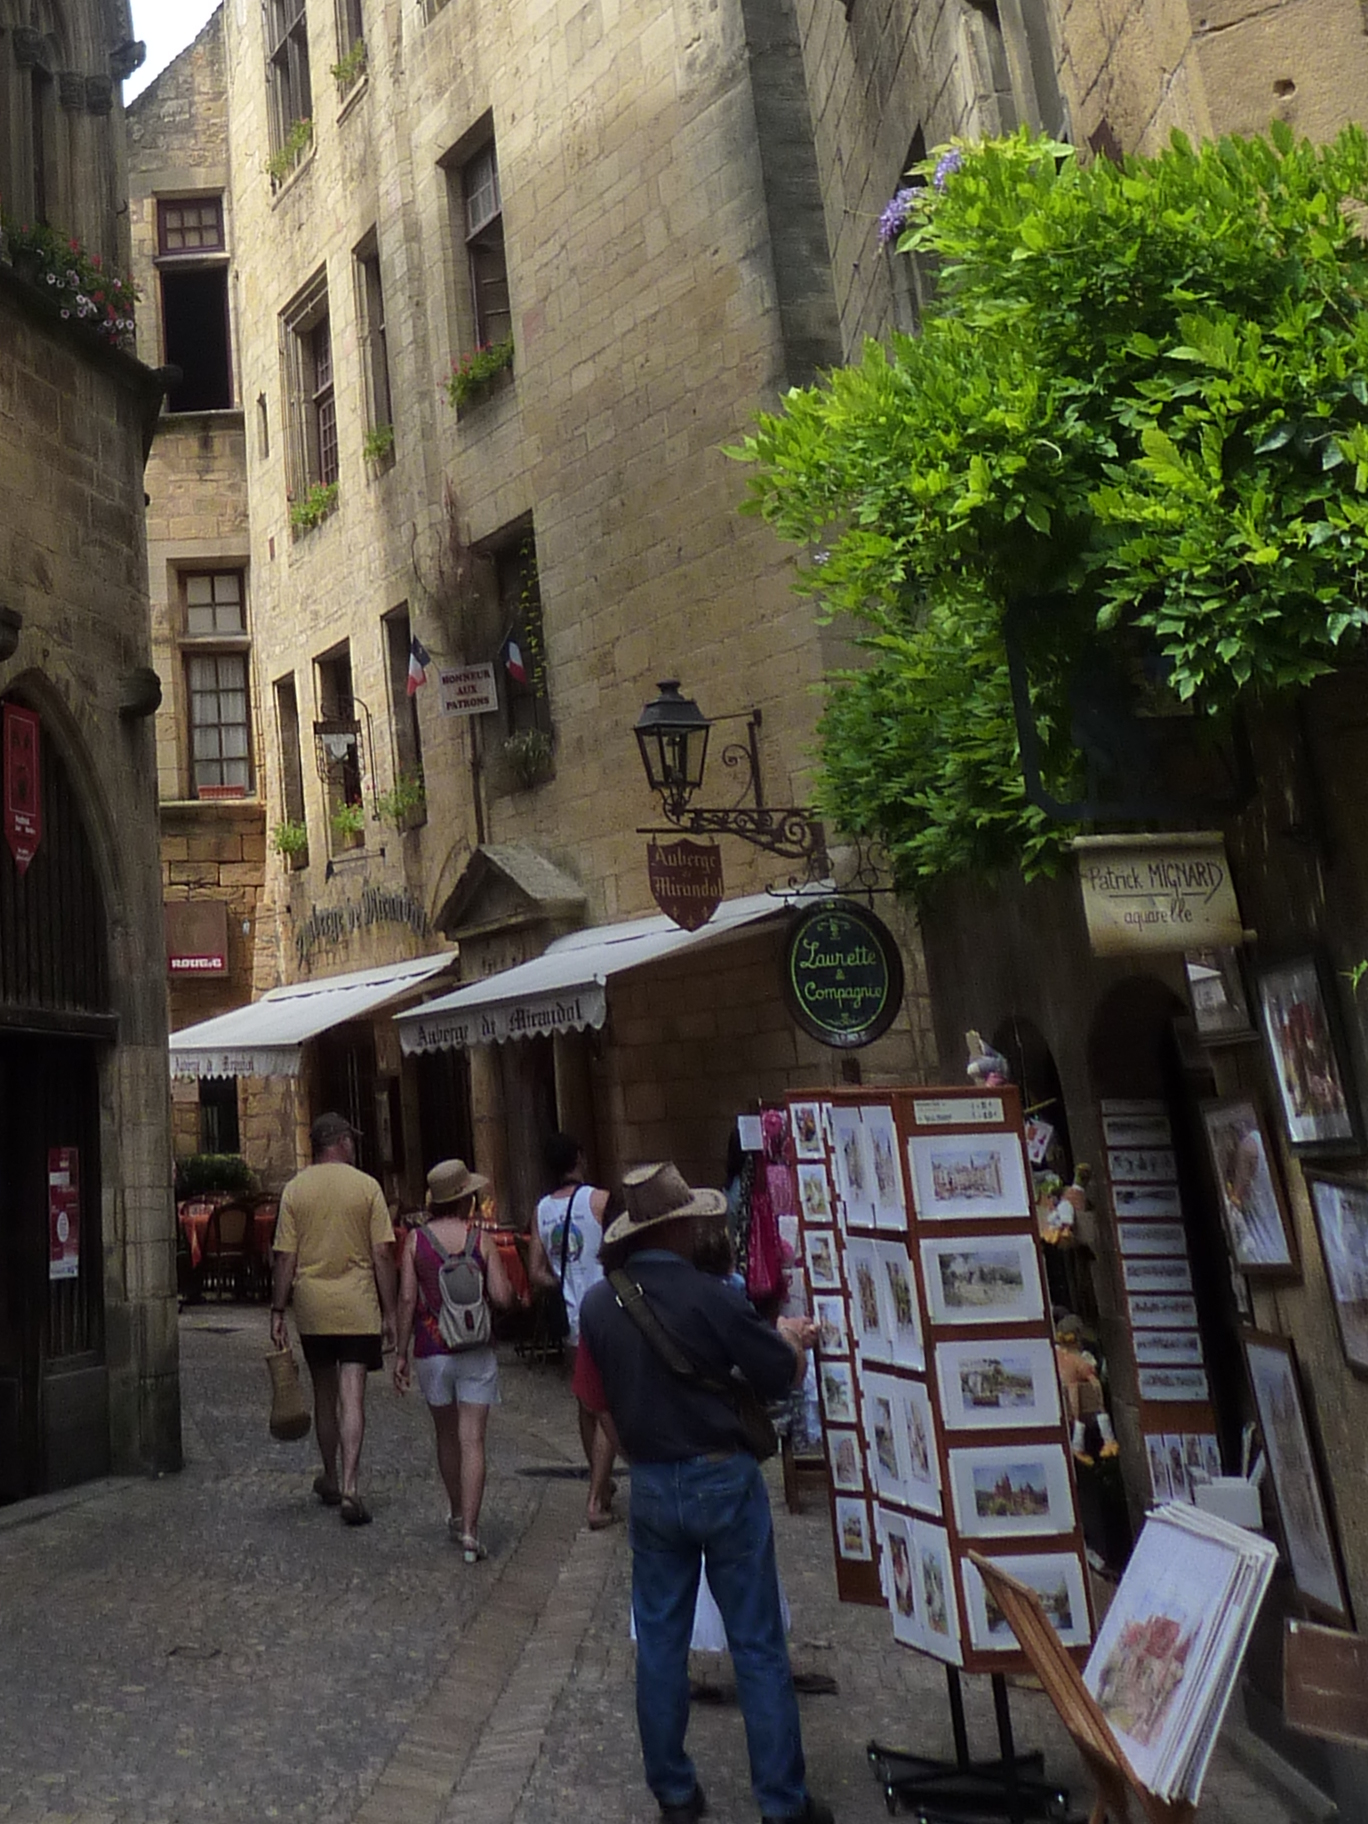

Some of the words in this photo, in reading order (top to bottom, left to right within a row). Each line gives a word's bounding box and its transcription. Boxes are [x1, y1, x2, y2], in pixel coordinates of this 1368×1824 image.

[442, 669, 491, 685] HONNEUR
[457, 685, 478, 695] AUX
[446, 696, 490, 711] PATRONS
[655, 846, 716, 875] Auberge
[653, 876, 725, 897] Mirandol
[1089, 865, 1143, 891] Patrick
[1148, 858, 1223, 904] MIGNARD
[1124, 896, 1194, 932] aquarelle
[800, 938, 877, 969] Laurette
[804, 981, 883, 1009] Compagnie
[417, 1025, 469, 1048] Auberge
[509, 998, 583, 1033] Mirandol
